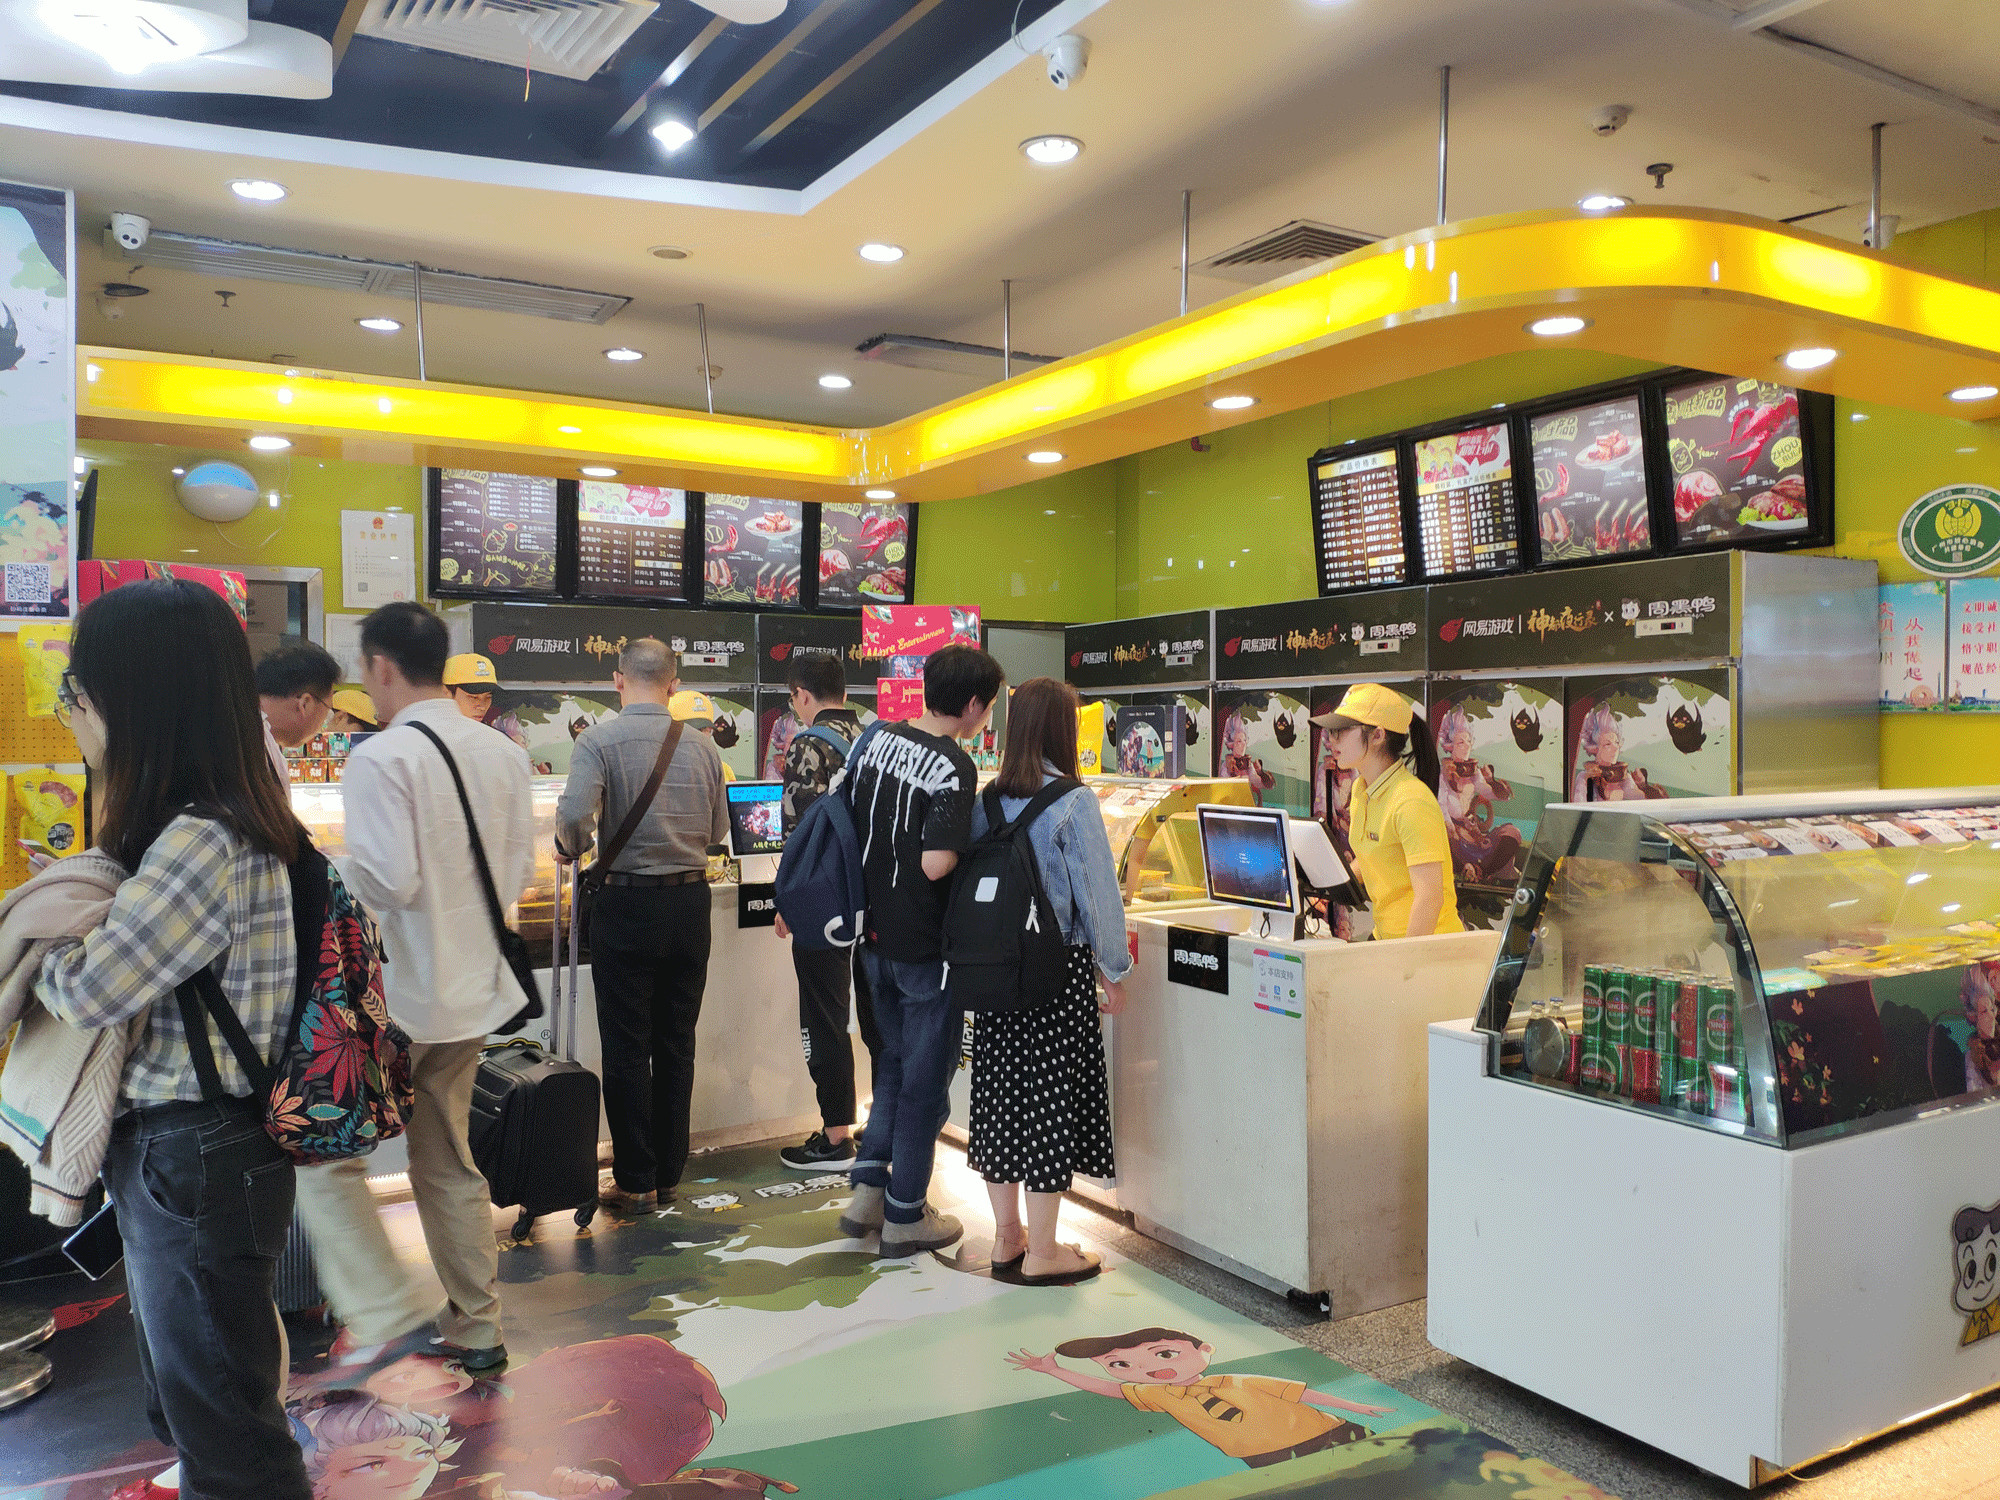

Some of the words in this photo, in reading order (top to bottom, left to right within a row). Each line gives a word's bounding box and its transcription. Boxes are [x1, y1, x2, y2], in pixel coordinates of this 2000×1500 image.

[1648, 596, 1716, 617] 周黑鸭
[1370, 623, 1417, 638] 周黑鸭
[1463, 618, 1514, 637] 网易游戏
[516, 638, 570, 653] 网易游戏
[693, 641, 745, 654] 周黑鸭
[866, 645, 896, 657] More
[1171, 640, 1204, 653] 周黑鸭
[1241, 638, 1277, 652] 网易游戏
[1903, 617, 1925, 681] 从我做起
[1082, 652, 1108, 664] 网易游戏
[1174, 949, 1219, 971] 周黑鸭
[1268, 967, 1294, 981] 本店支持
